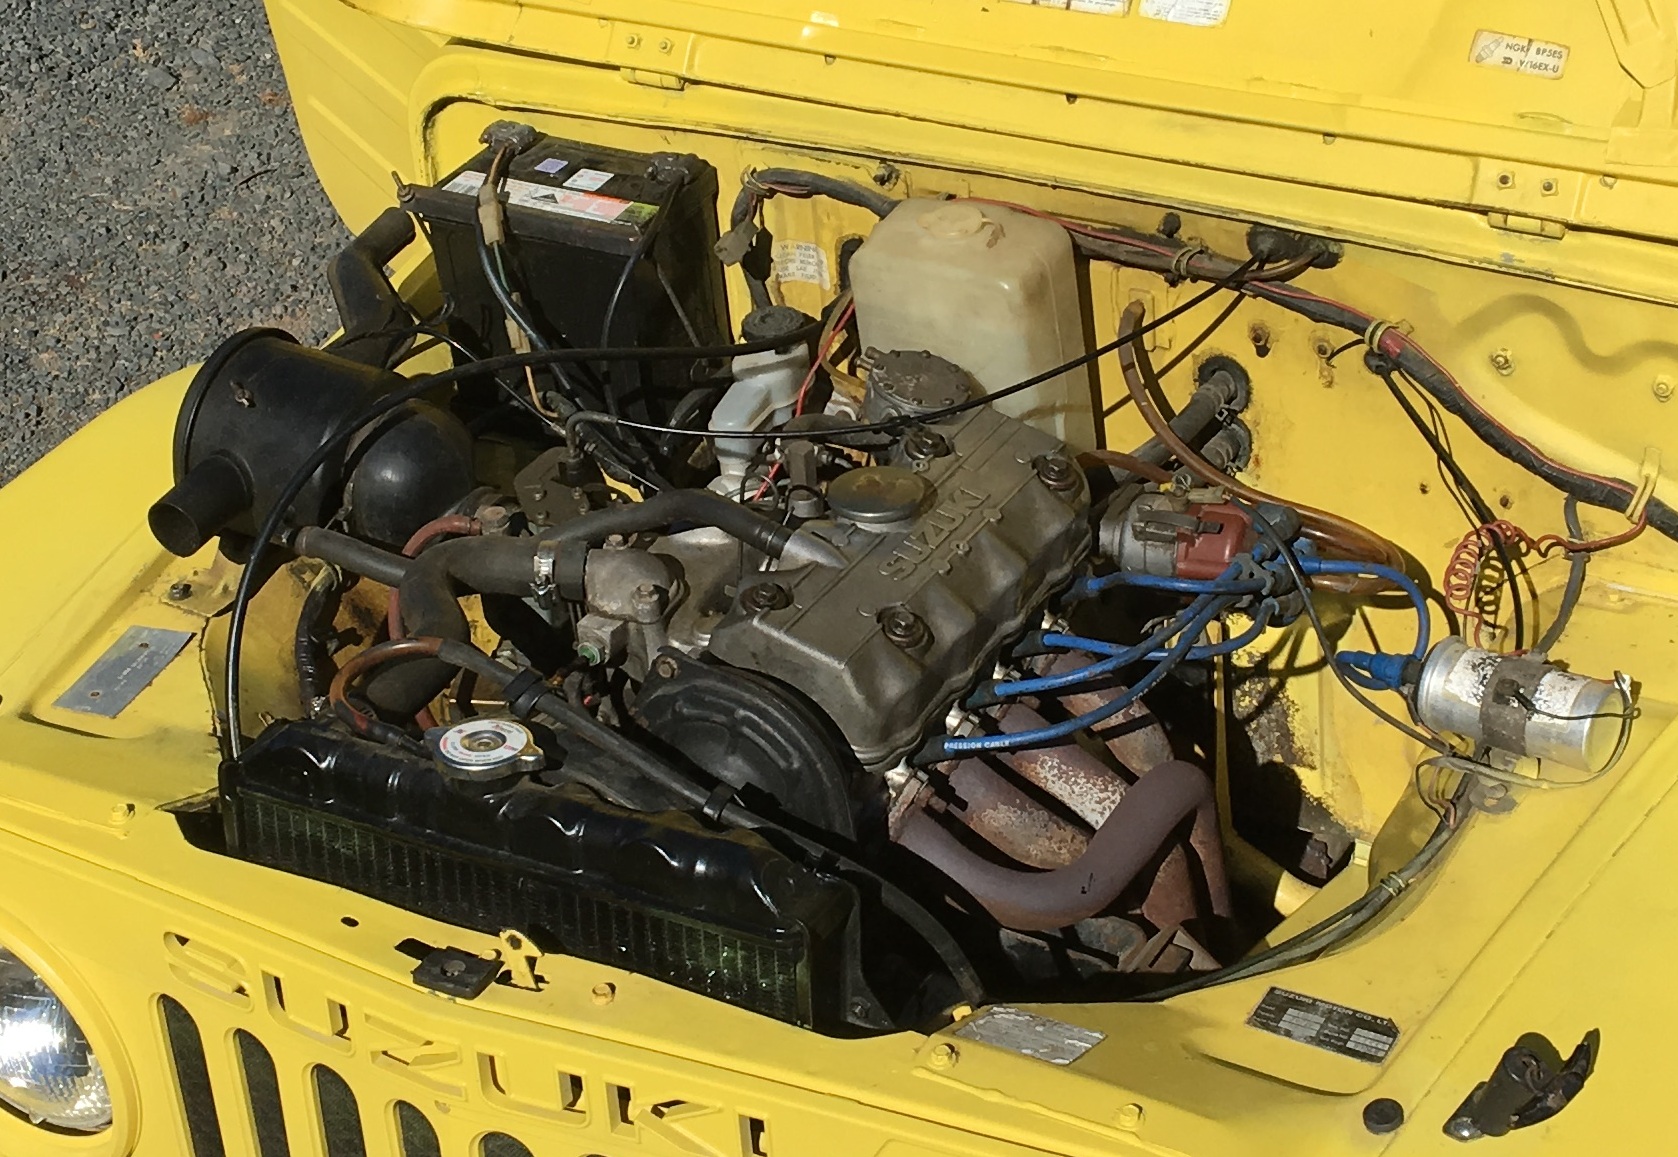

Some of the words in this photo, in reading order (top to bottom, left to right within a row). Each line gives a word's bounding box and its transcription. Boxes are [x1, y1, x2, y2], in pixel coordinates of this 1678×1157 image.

[1505, 42, 1527, 54] NGK
[878, 486, 992, 581] SUZUKI
[1273, 989, 1312, 1004] SUZUKI
[1315, 1001, 1354, 1016] MOTOR
[162, 930, 772, 1157] SUZUKI
